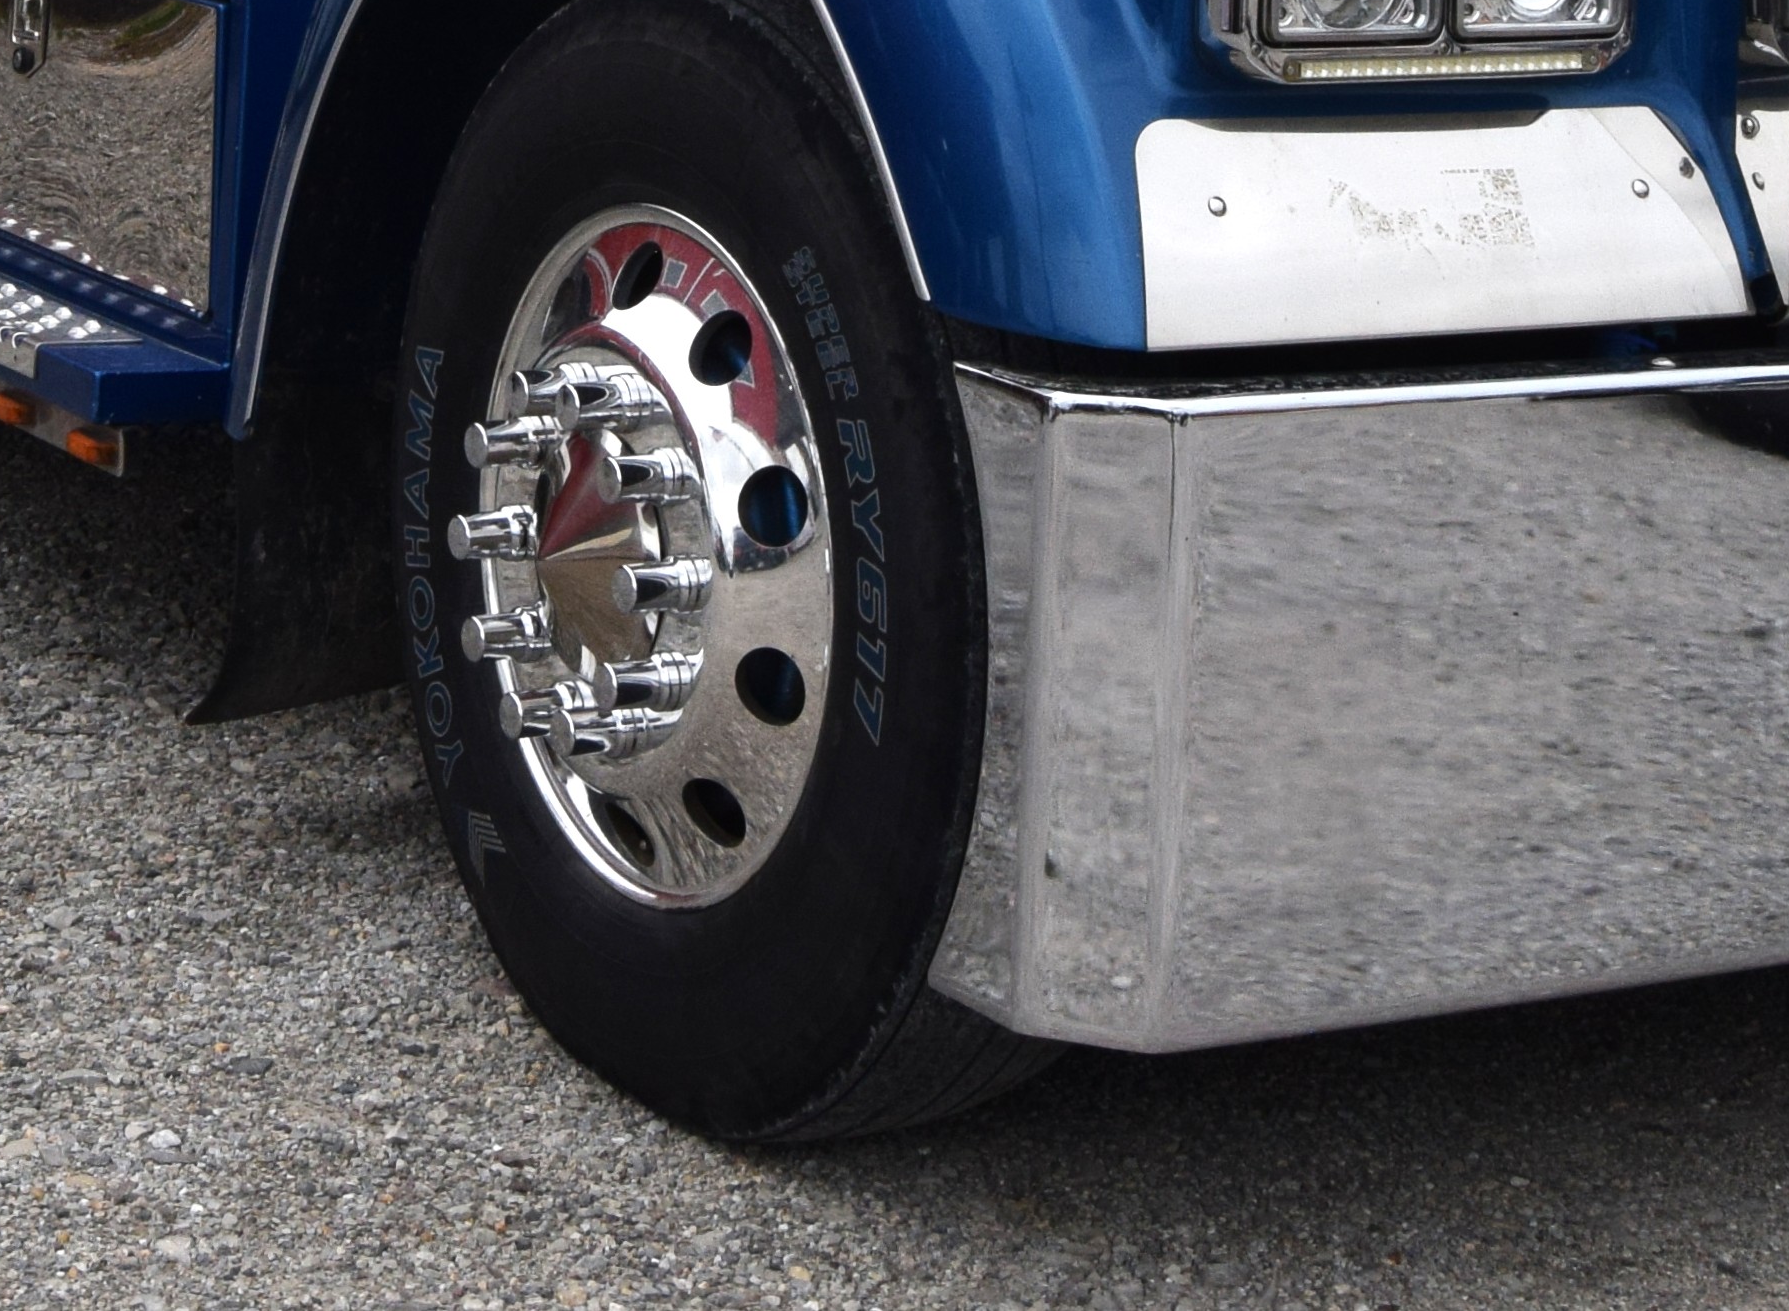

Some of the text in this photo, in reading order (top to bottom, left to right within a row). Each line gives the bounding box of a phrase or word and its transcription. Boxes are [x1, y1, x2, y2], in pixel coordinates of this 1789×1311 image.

[793, 245, 859, 401] SUPER
[403, 345, 464, 789] YOKOHAMA
[836, 418, 887, 747] RY617
